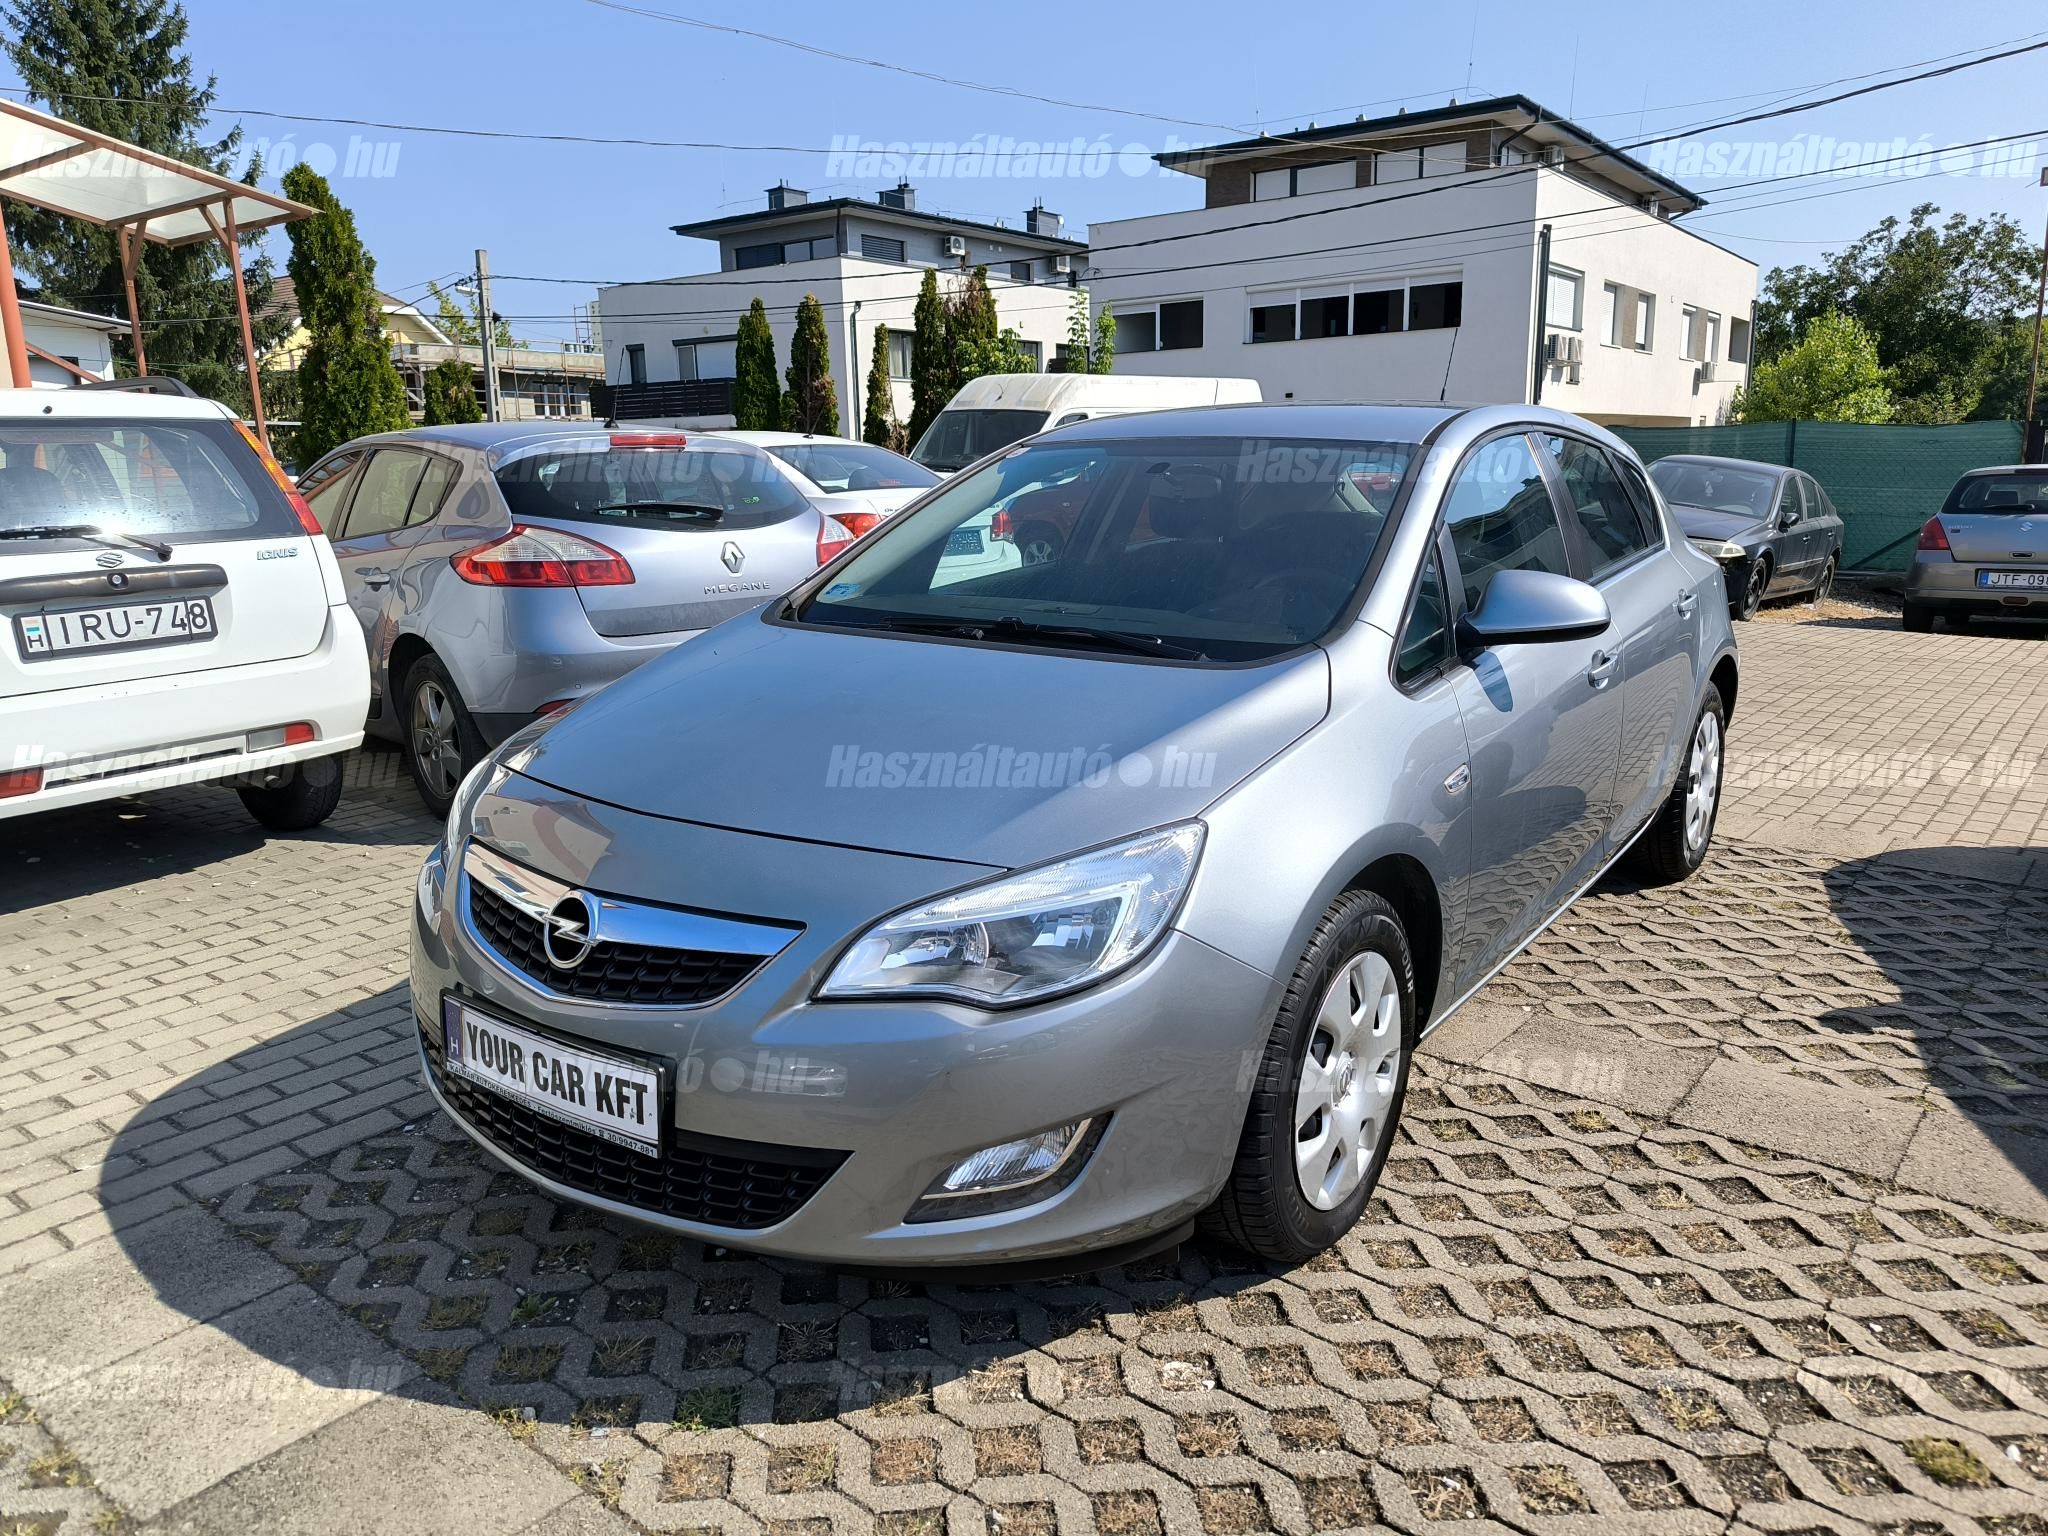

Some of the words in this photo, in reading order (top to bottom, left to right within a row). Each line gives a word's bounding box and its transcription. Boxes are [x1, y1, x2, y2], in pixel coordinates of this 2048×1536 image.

[257, 548, 298, 560] IGNIS
[704, 581, 771, 594] MEGANE
[60, 602, 208, 644] IRU-748
[27, 635, 44, 649] H
[450, 1039, 459, 1054] H
[466, 1021, 526, 1083] YOUR
[532, 1051, 586, 1107] CAR
[594, 1072, 648, 1125] KFT
